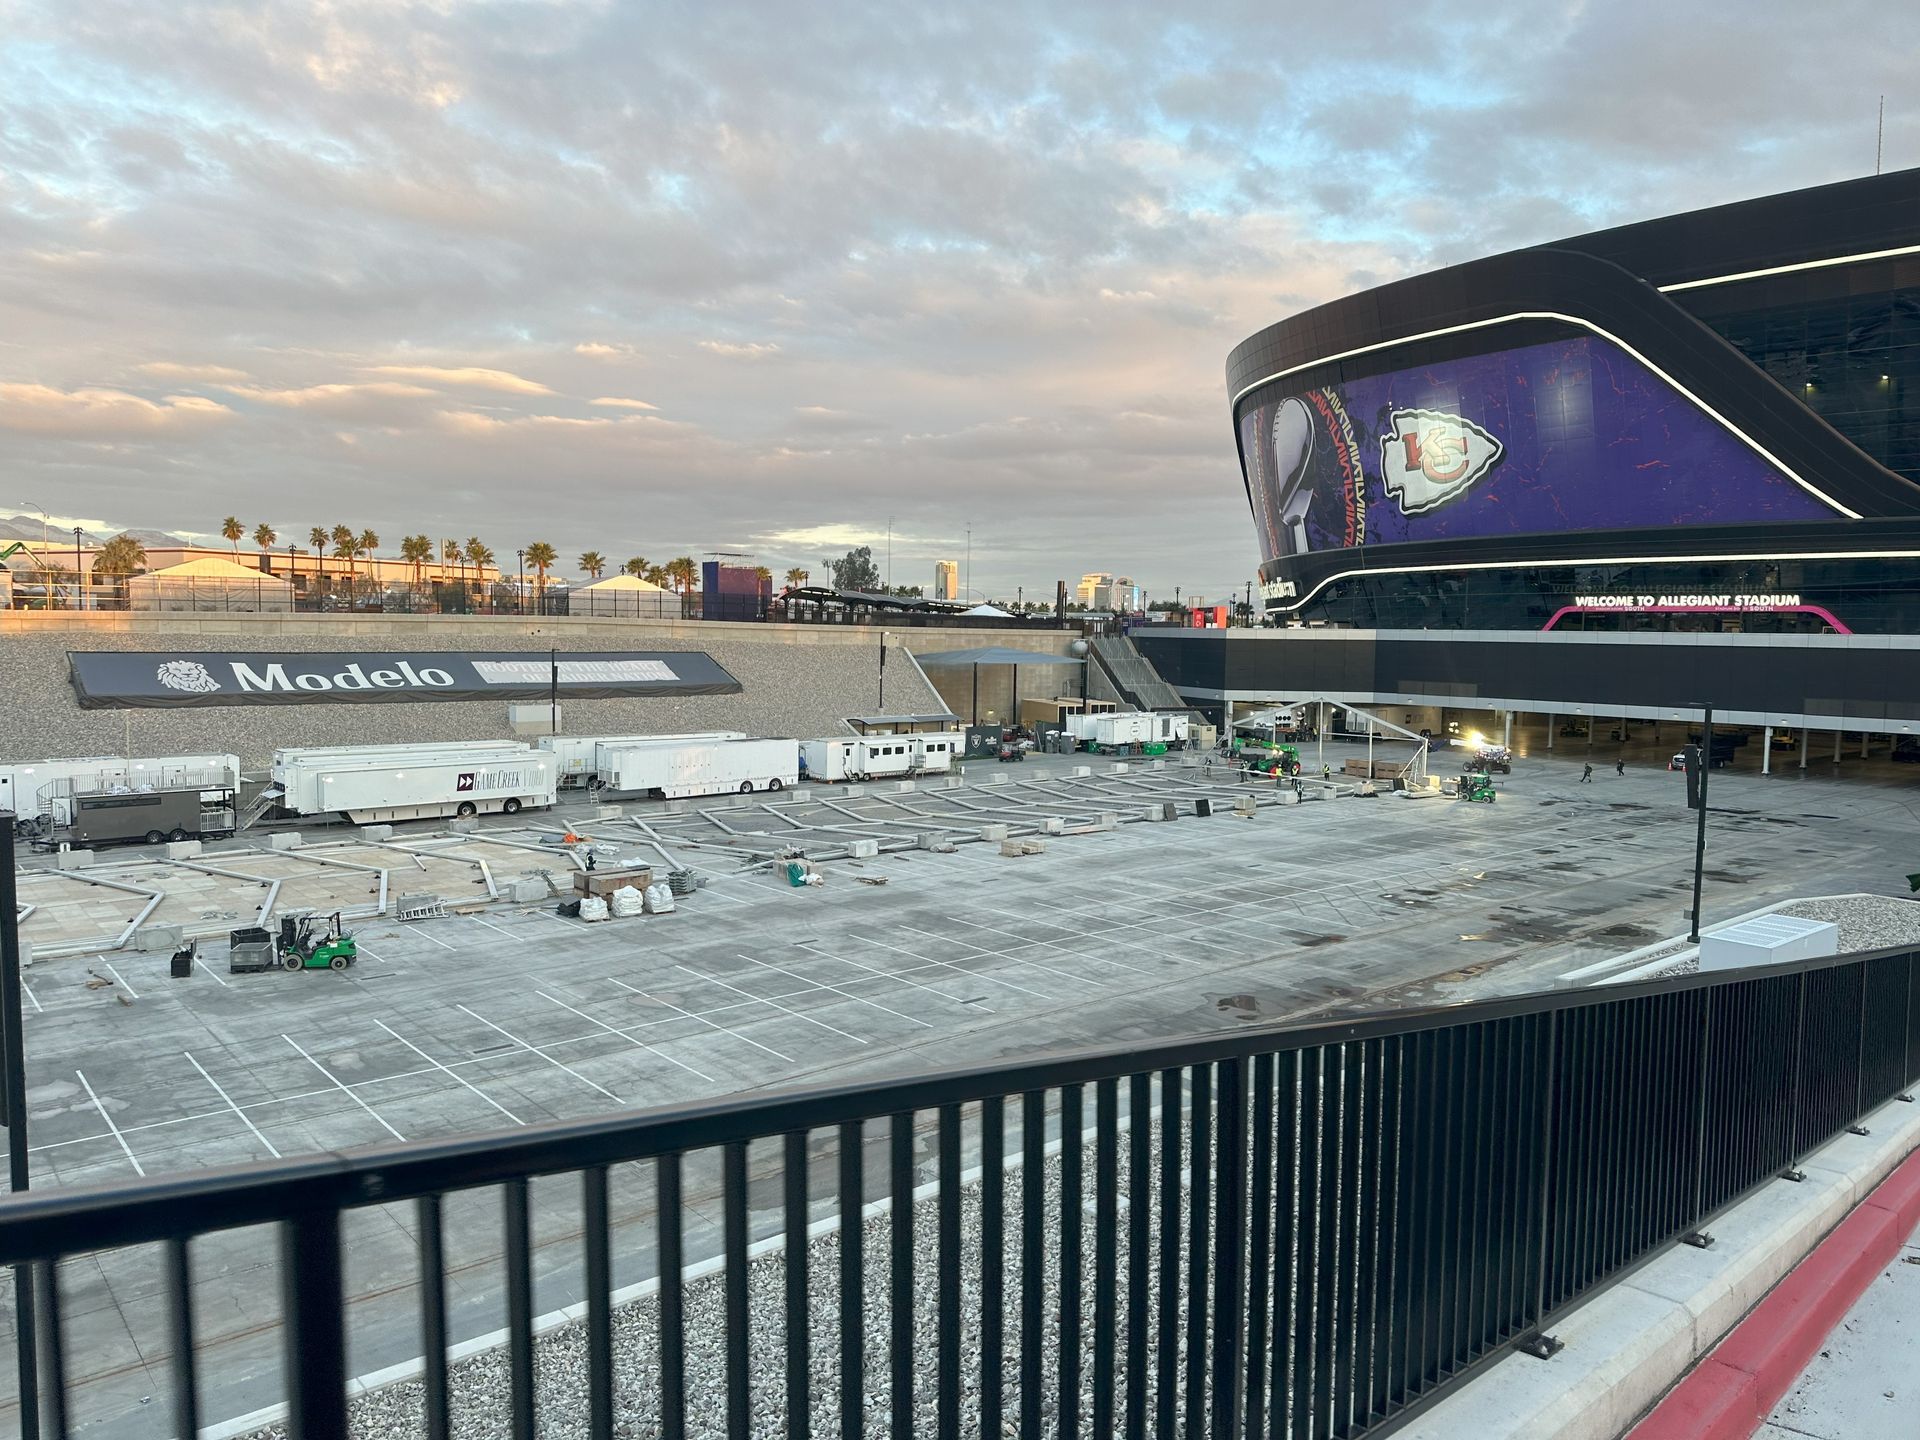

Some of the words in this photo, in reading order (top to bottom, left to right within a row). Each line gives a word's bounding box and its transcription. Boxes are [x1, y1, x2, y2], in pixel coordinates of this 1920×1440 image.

[1402, 428, 1469, 484] KC
[1575, 596, 1634, 607] WELCOME
[1637, 596, 1655, 606] TO
[1657, 595, 1731, 606] ALLEGIANT
[1734, 595, 1800, 606] STADIUM
[229, 661, 454, 691] Modelo
[481, 663, 551, 673] ROOTED
